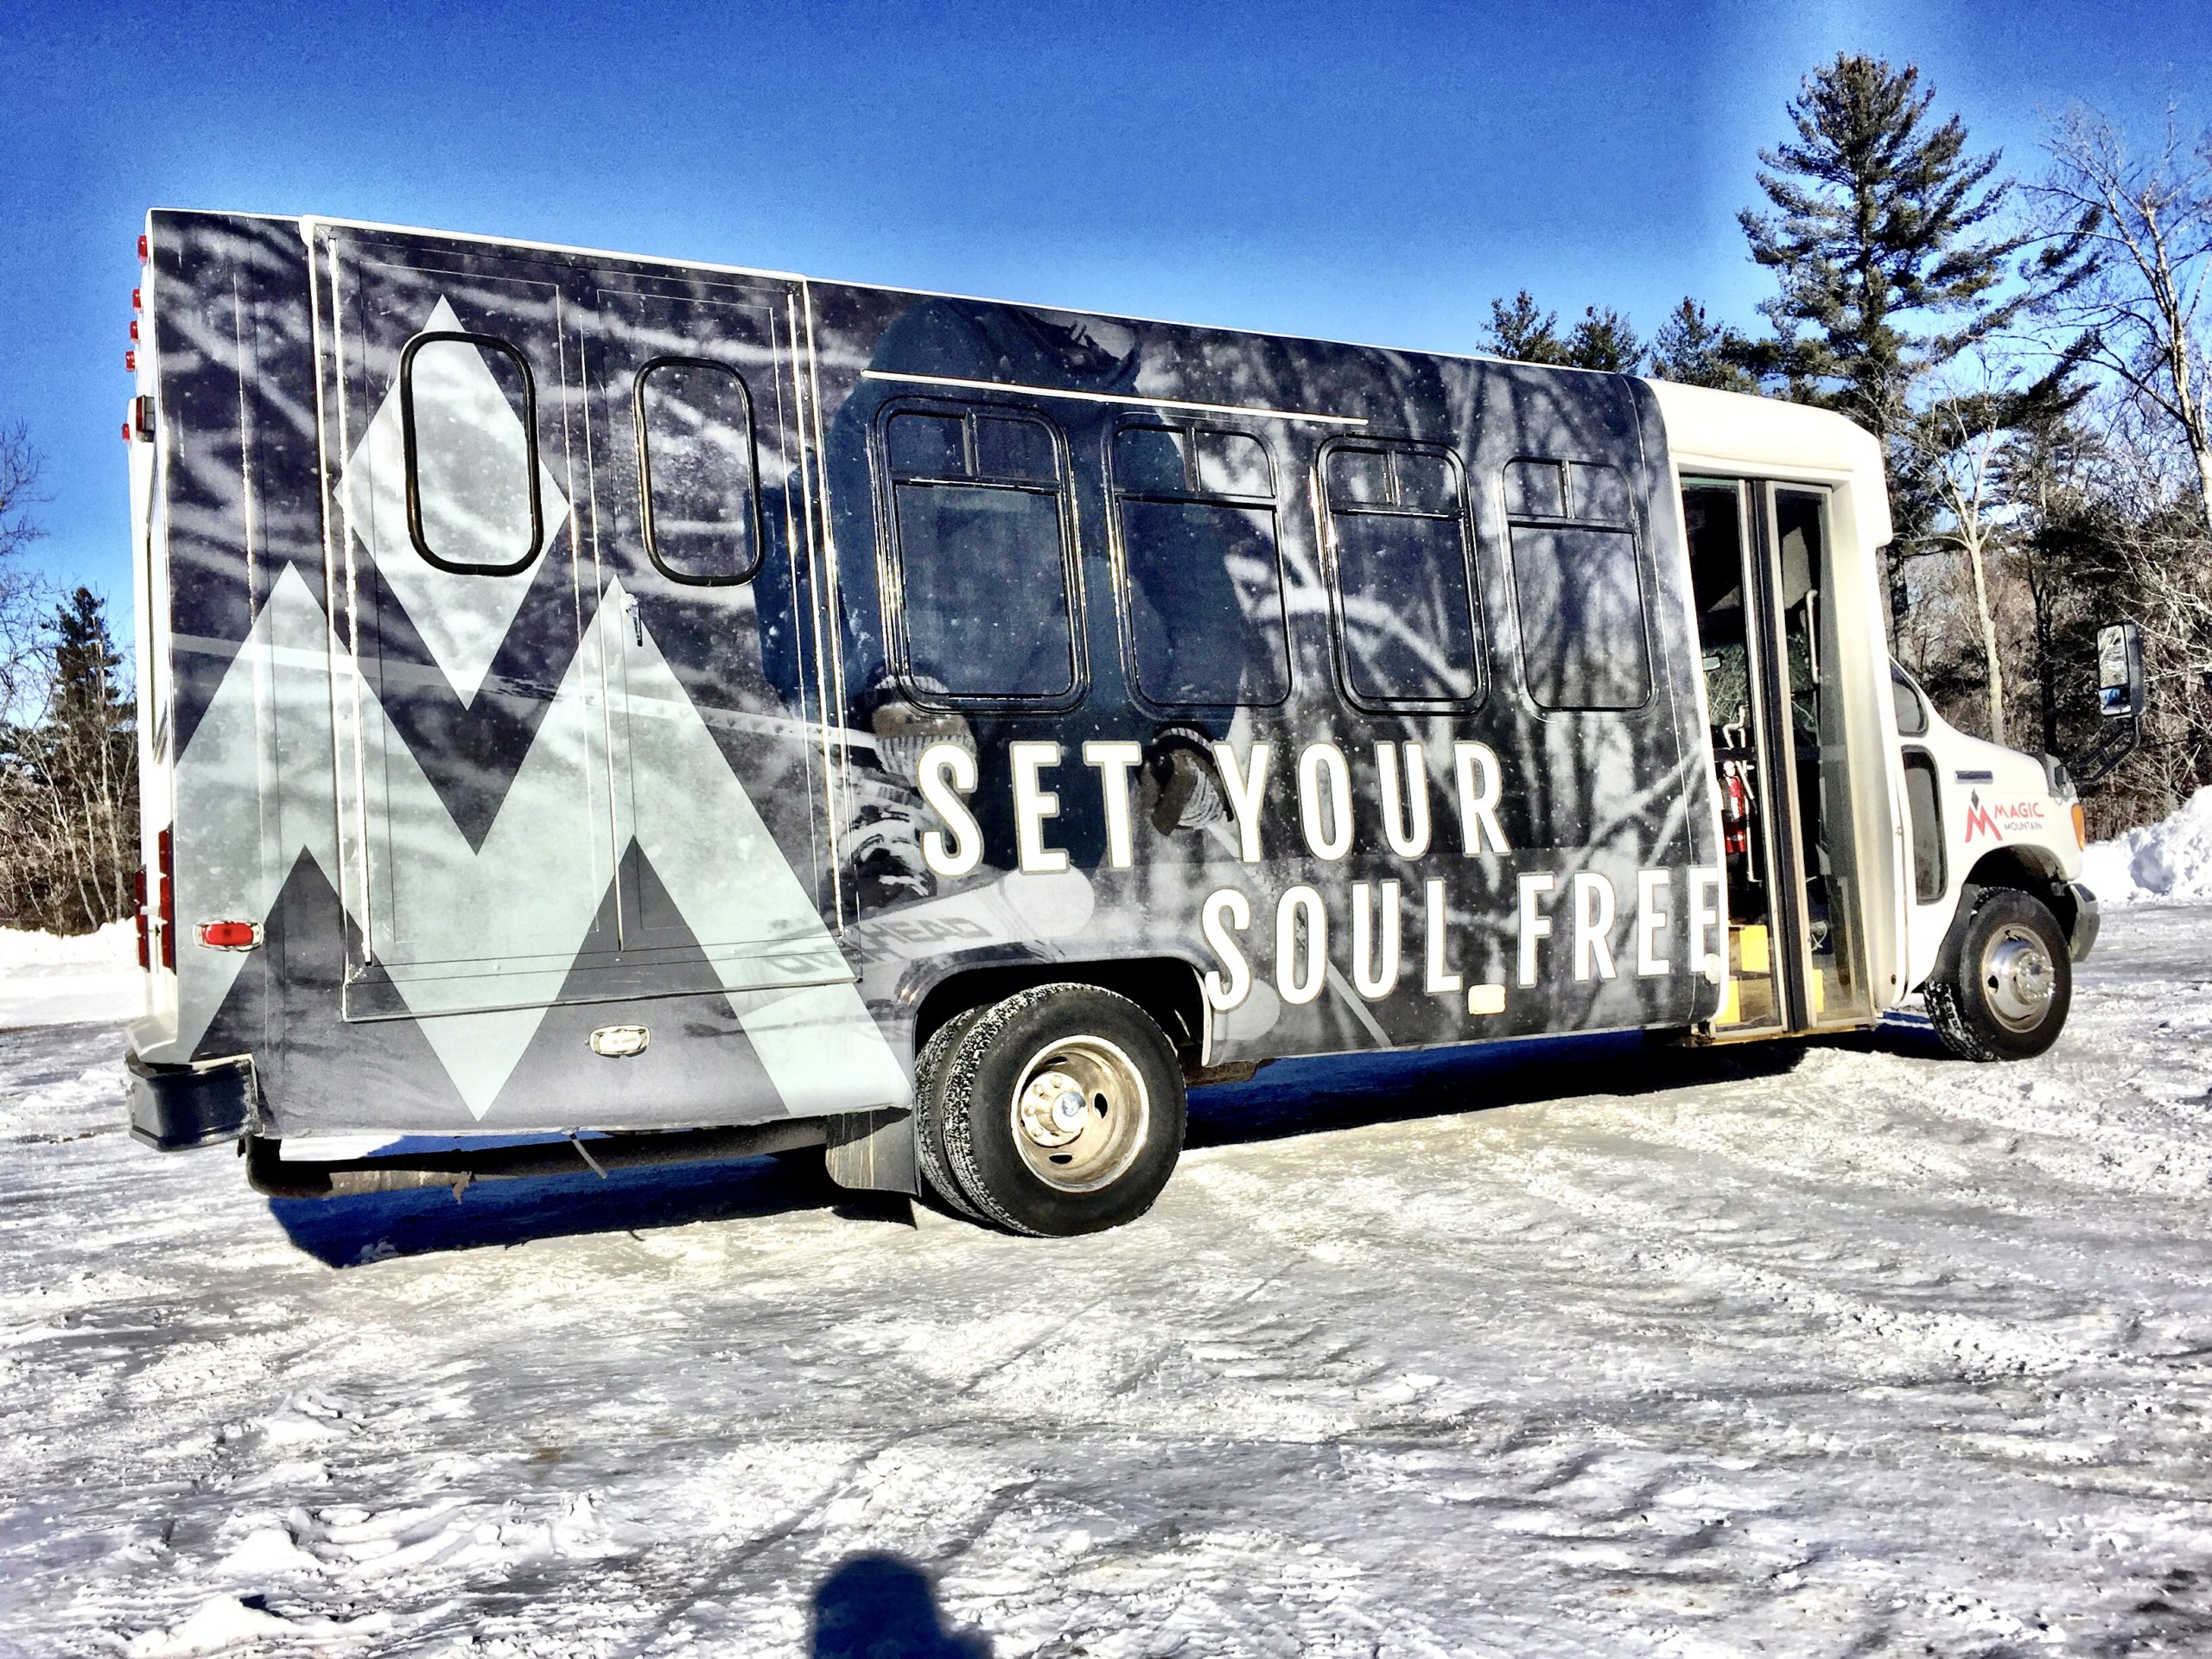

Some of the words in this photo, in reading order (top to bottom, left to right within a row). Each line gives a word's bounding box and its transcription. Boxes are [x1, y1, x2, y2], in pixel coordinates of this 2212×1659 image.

[918, 741, 1142, 876] SET
[1212, 741, 1511, 863] YOUR
[1993, 802, 2044, 819] MAGIC
[2004, 821, 2043, 831] MOUNTAIN
[1201, 876, 1463, 1013] SOUL
[1516, 865, 1720, 989] FREE
